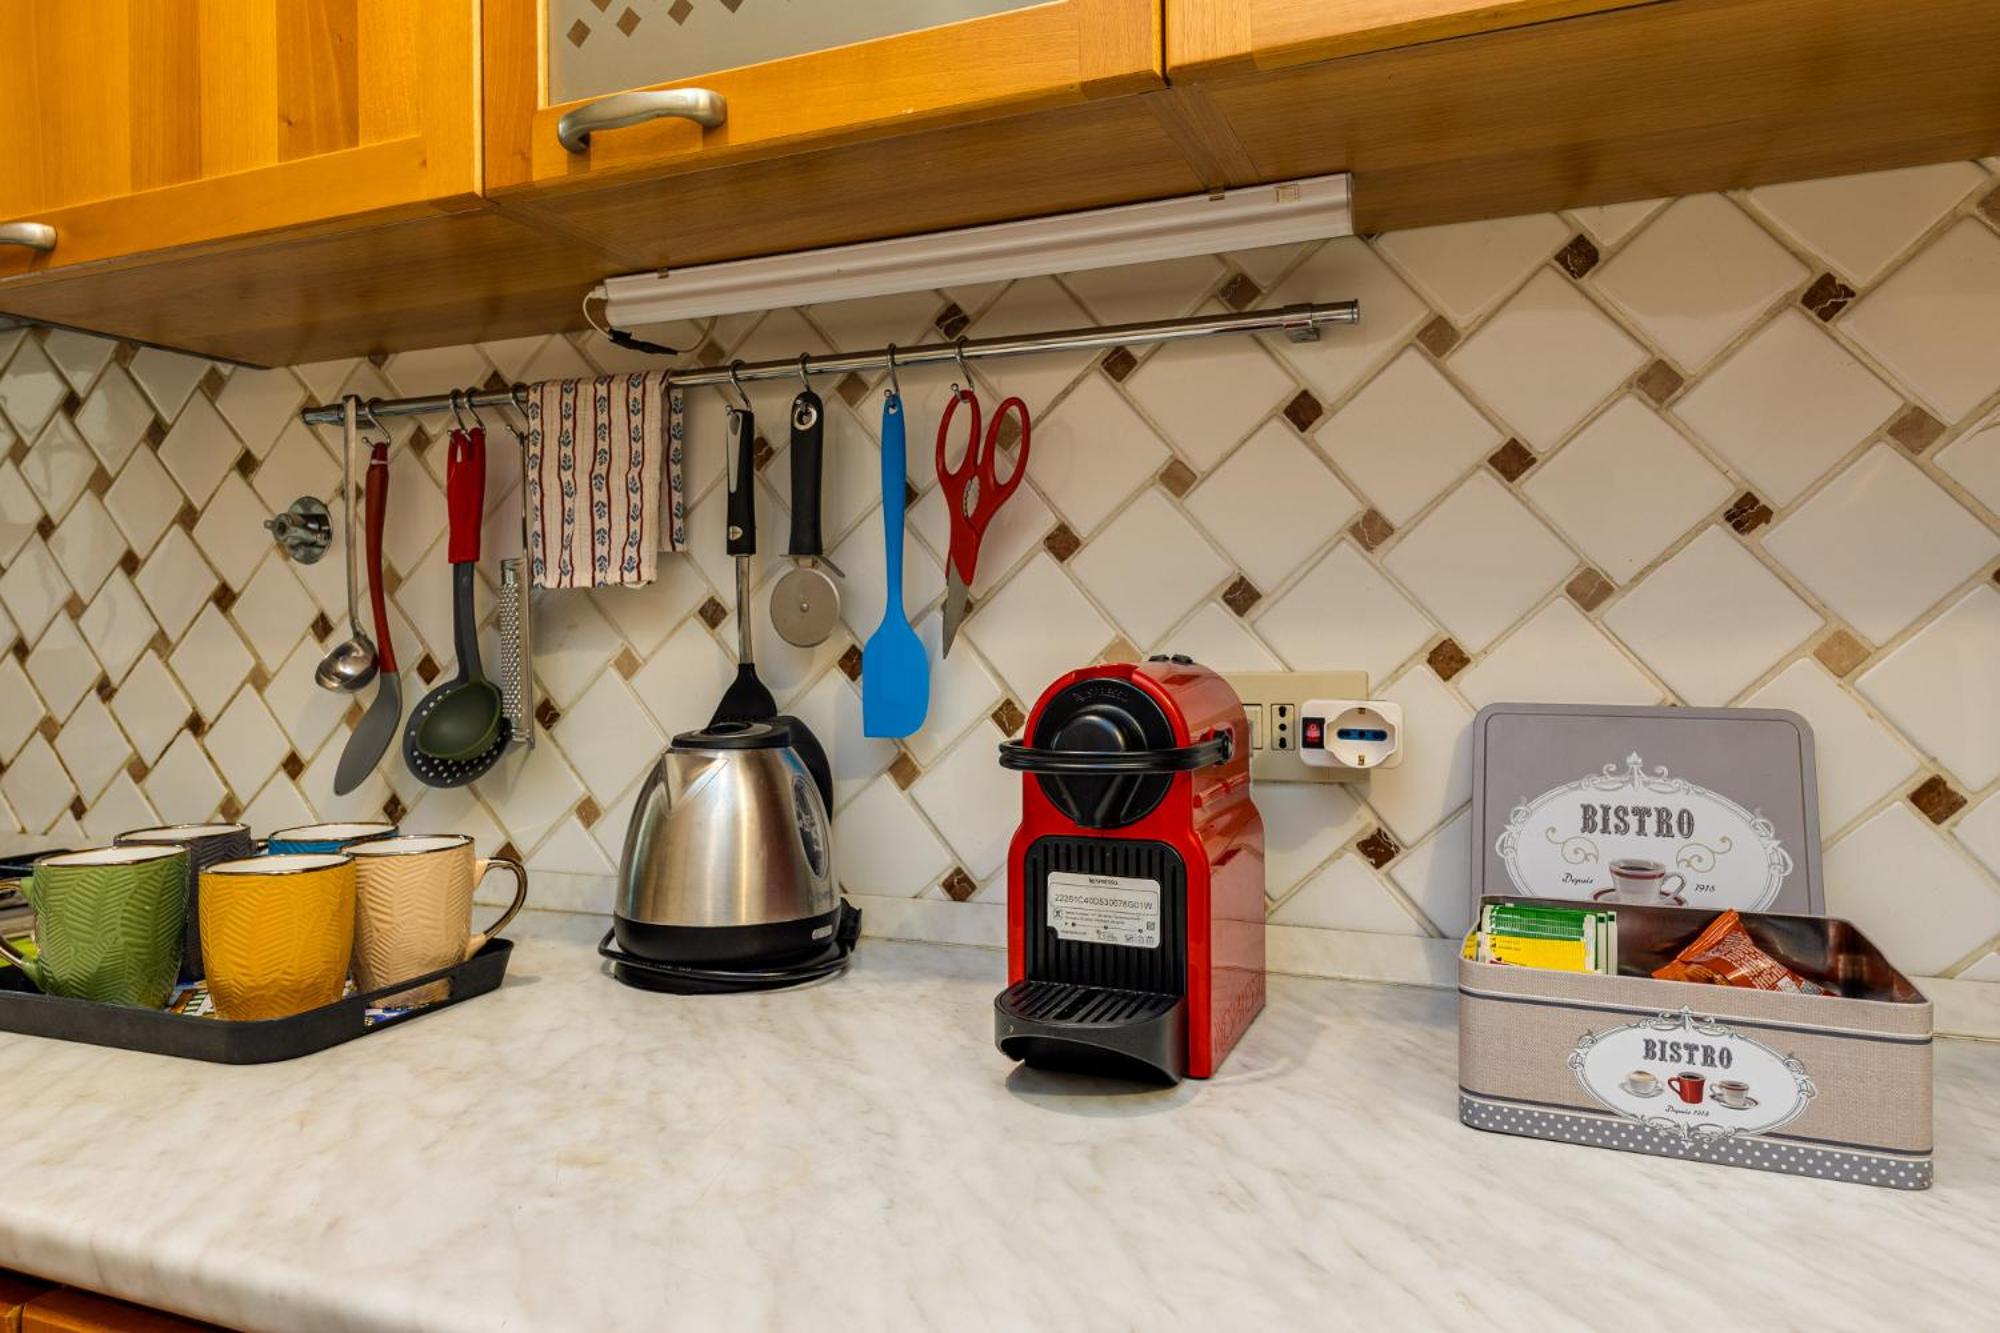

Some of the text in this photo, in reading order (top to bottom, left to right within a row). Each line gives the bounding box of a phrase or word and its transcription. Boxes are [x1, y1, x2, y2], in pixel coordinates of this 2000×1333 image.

[1580, 803, 1695, 839] BISTRO
[1561, 872, 1595, 885] Depuis
[1643, 1038, 1733, 1070] BISTRO
